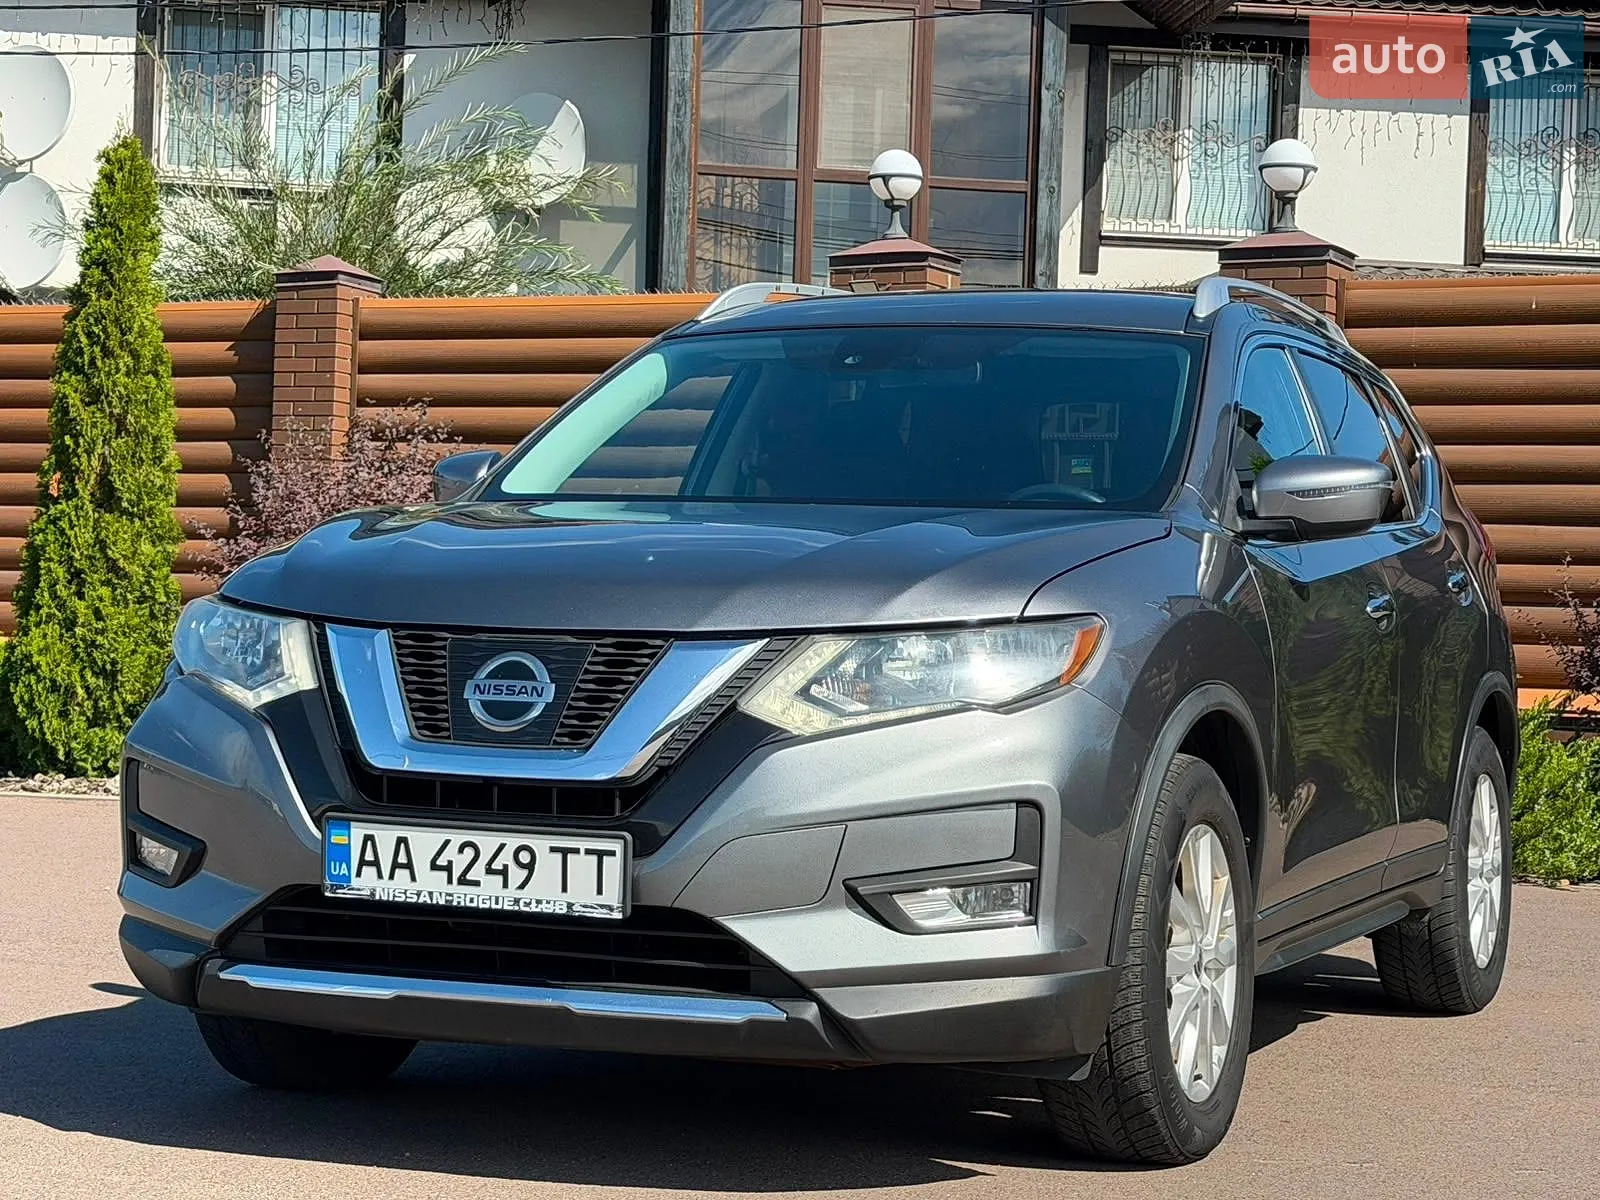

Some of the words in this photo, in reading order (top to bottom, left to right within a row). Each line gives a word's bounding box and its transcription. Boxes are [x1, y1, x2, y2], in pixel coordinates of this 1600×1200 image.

[473, 683, 545, 698] NISSAN
[331, 861, 349, 876] UA
[355, 833, 417, 883] AA
[429, 838, 537, 891] 4249
[549, 845, 616, 896] TT
